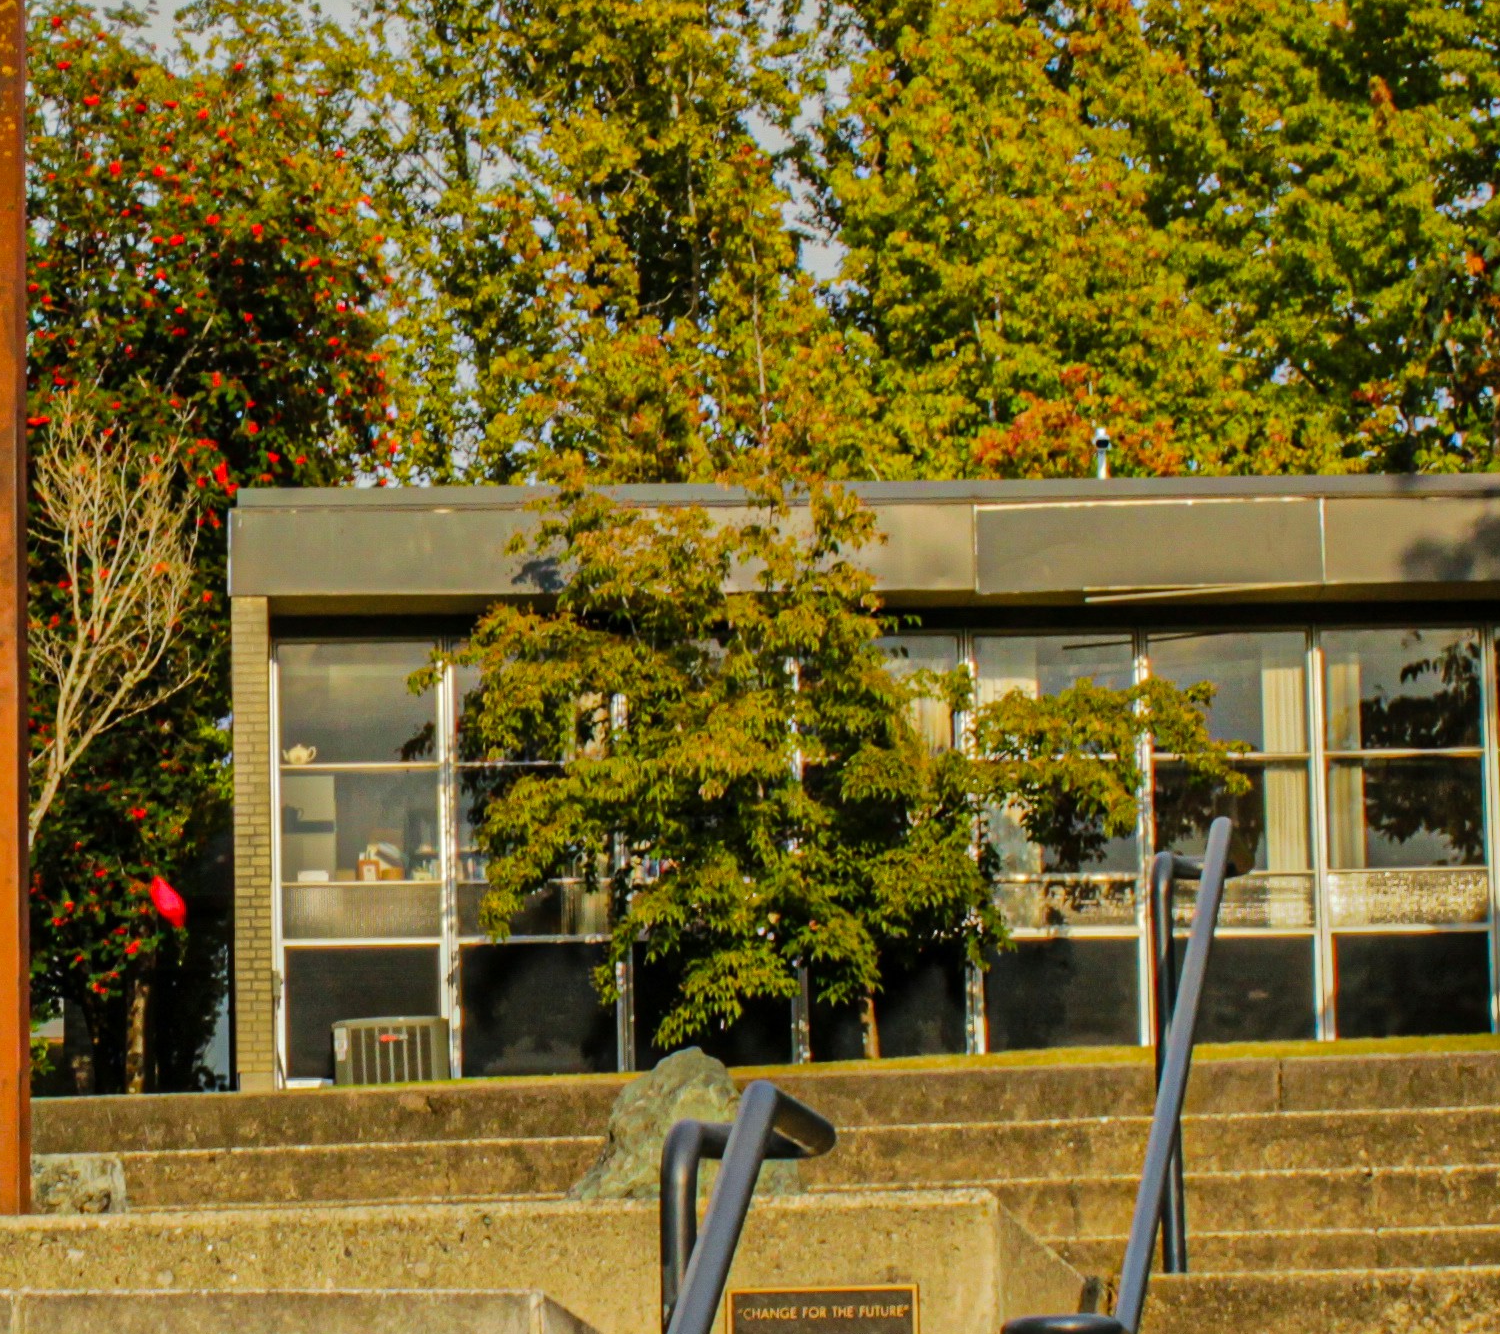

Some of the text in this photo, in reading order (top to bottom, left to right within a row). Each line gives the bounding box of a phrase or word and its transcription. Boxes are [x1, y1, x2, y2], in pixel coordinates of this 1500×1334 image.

[737, 1303, 910, 1321] "CHANGE FOR THE FUTURE"
